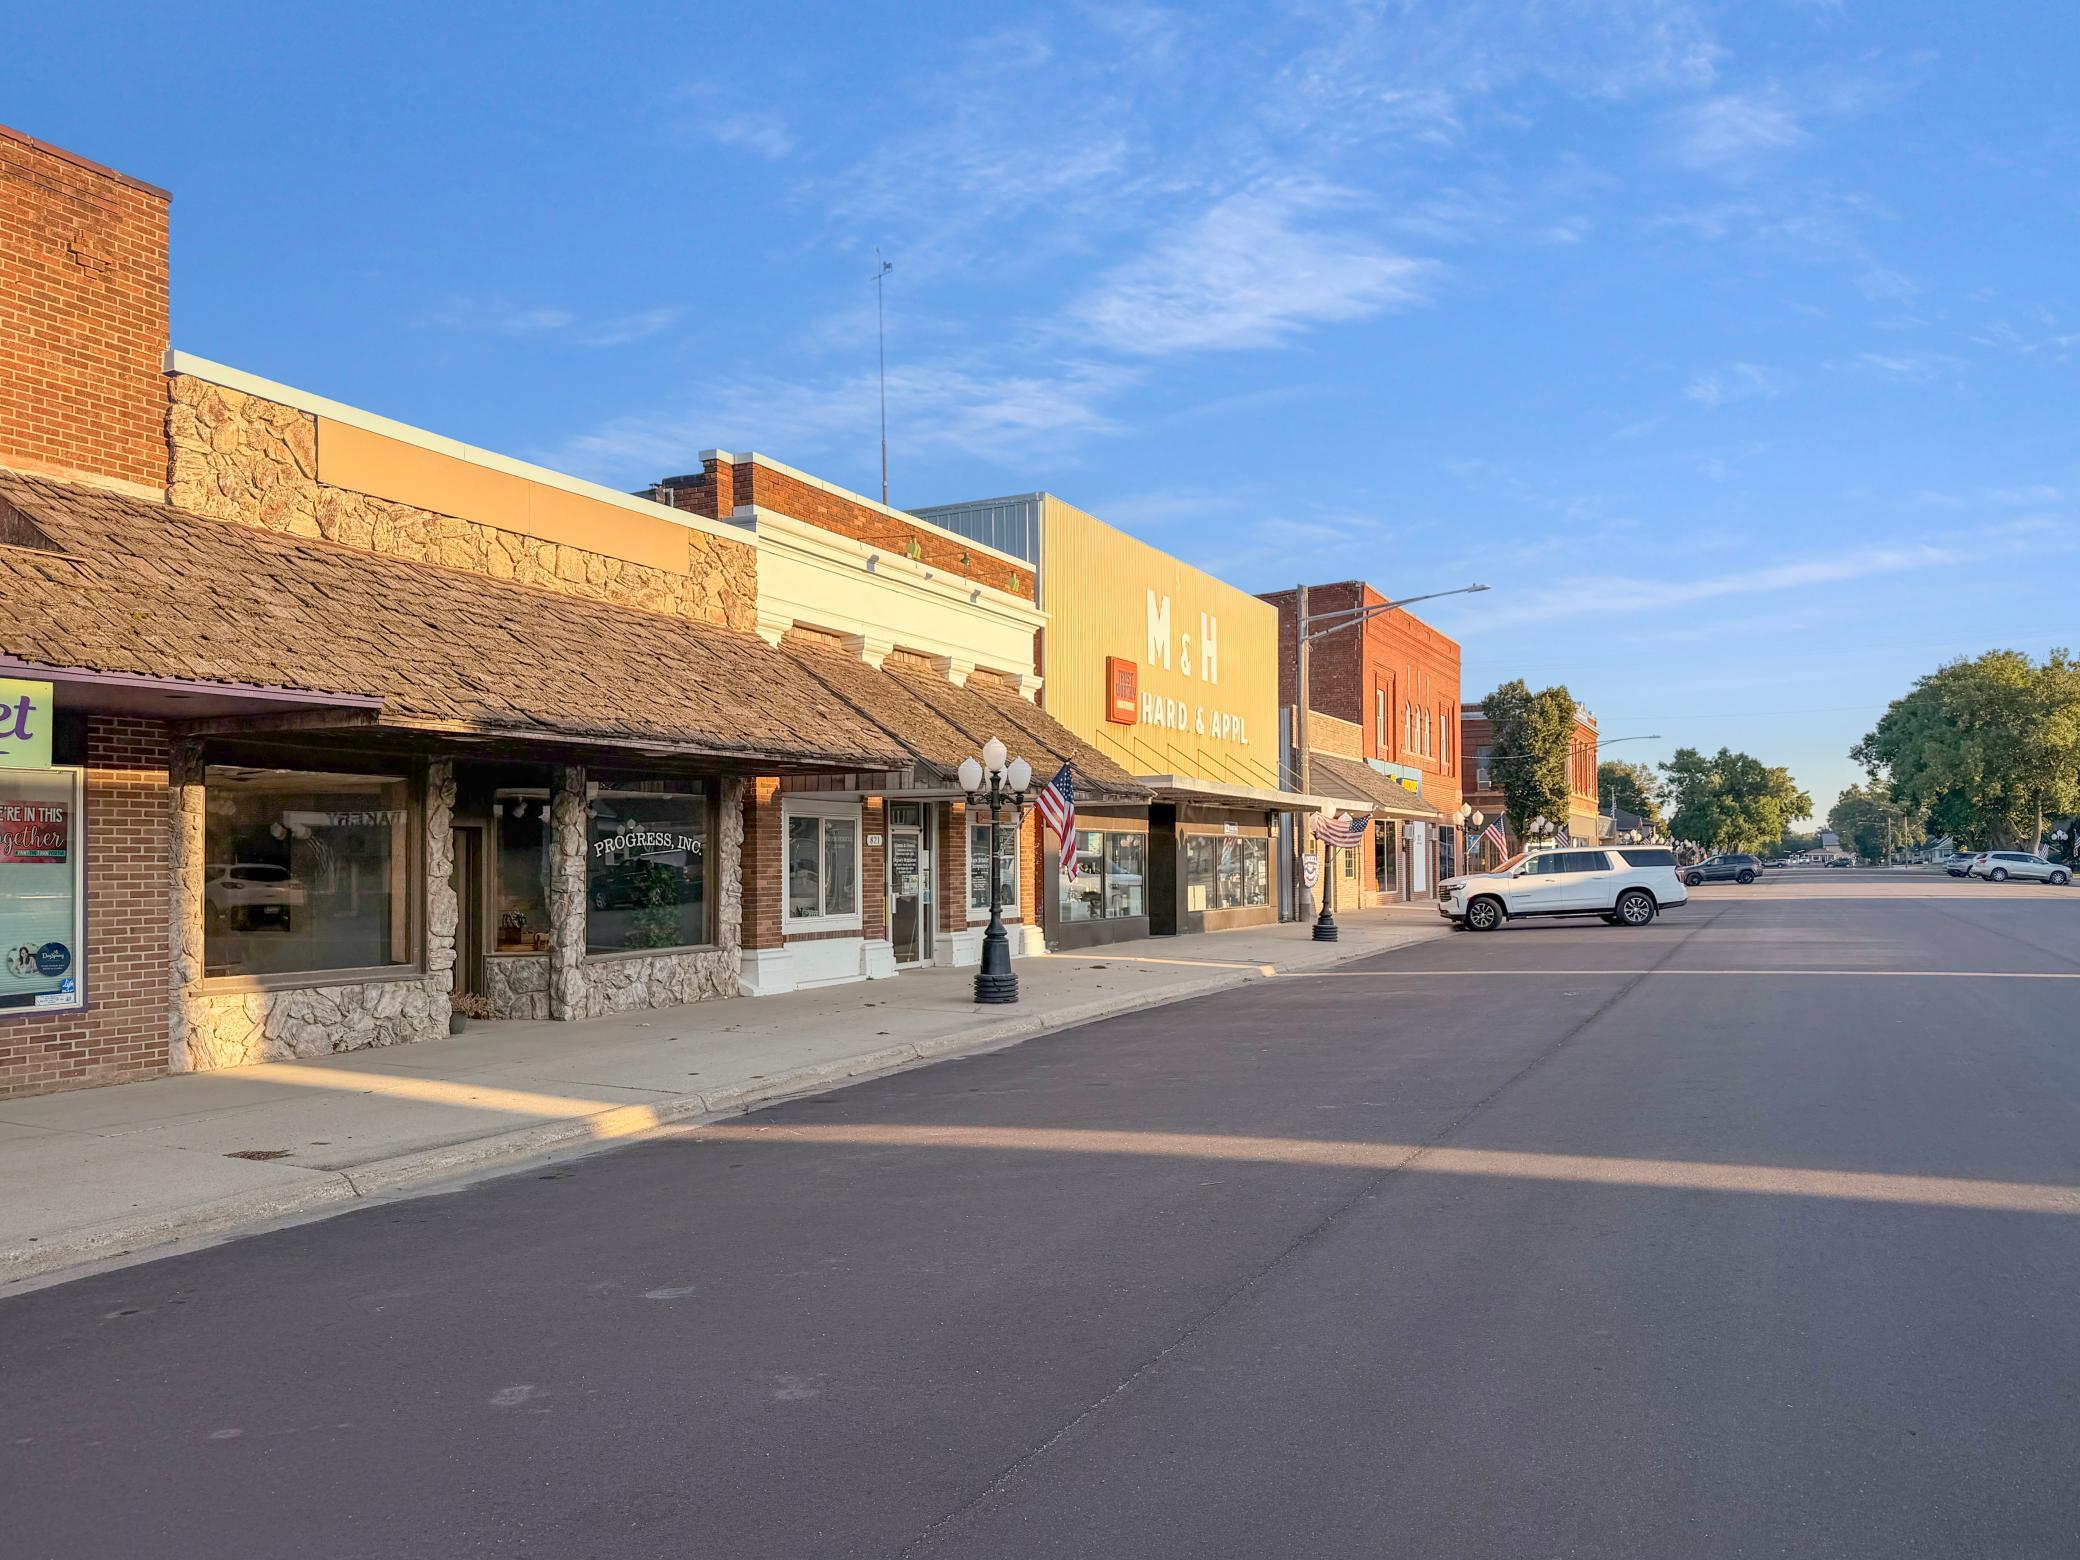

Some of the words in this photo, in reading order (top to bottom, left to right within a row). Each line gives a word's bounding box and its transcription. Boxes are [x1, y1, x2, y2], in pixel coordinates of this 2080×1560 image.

[1146, 588, 1171, 671] M
[1180, 632, 1192, 678] &
[1200, 611, 1218, 685] H
[1195, 706, 1205, 736] &
[24, 807, 35, 822] IN
[39, 807, 63, 823] THIS
[0, 825, 64, 856] gether
[593, 832, 675, 858] PROGRESS,
[677, 835, 702, 856] INC.
